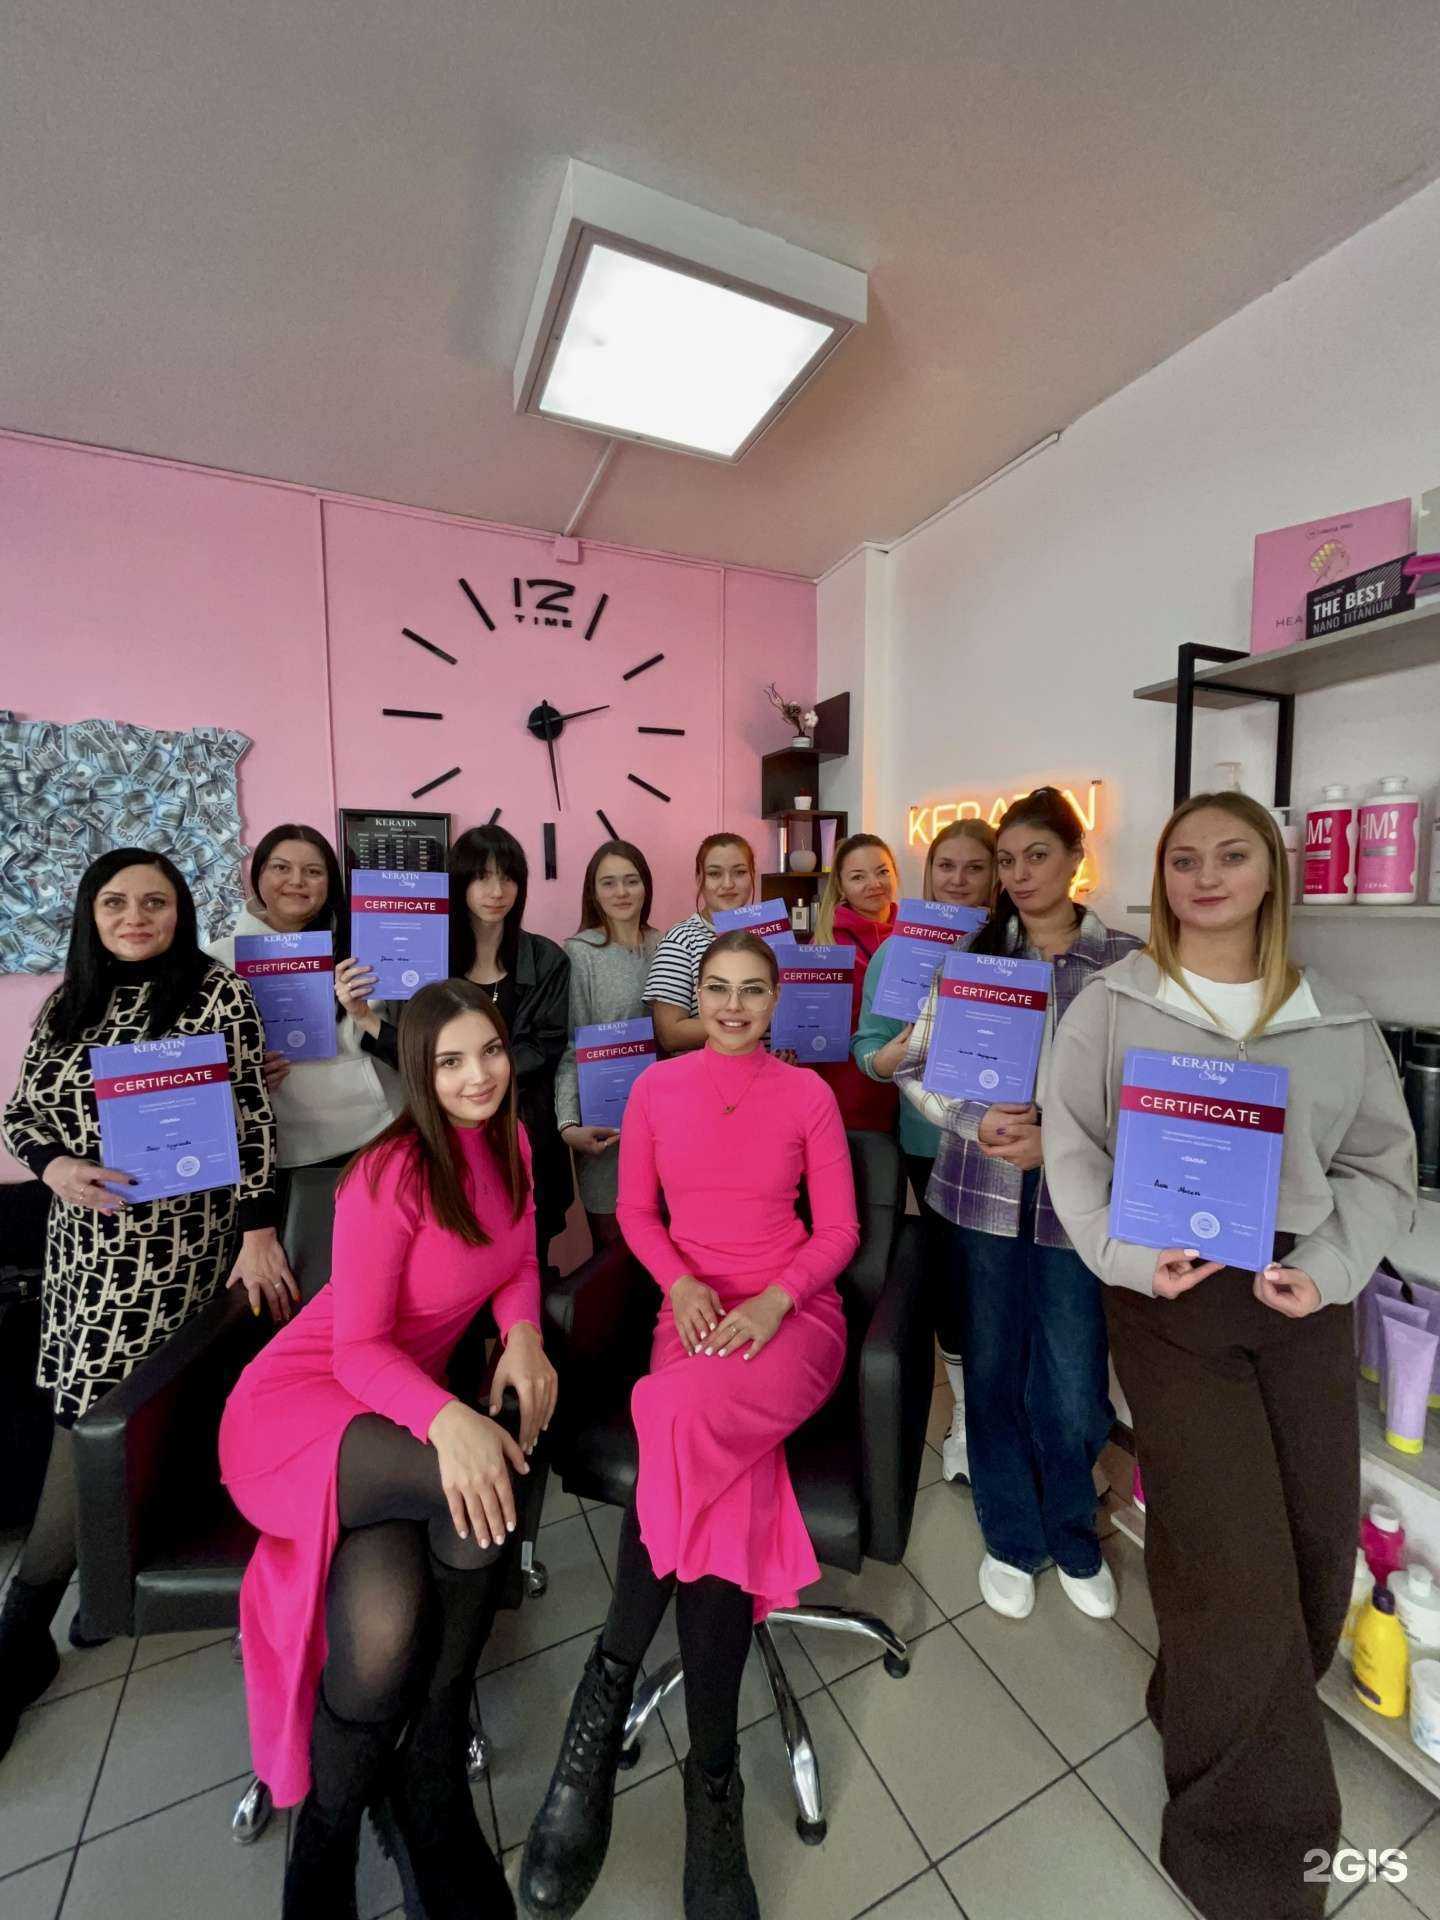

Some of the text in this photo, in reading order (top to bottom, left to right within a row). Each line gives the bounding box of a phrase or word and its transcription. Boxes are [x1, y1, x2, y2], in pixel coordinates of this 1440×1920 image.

[513, 577, 576, 613] 12
[1312, 598, 1341, 621] THE
[1345, 581, 1385, 610] BEST
[514, 614, 572, 628] TIME
[1275, 615, 1303, 629] HEA
[1312, 599, 1394, 634] NANO TITANIUM
[375, 818, 417, 827] KERATIN
[908, 785, 1097, 846] KERAN
[1305, 816, 1334, 845] M!
[382, 871, 419, 880] KERATIN
[364, 900, 436, 911] CERTIFICATE
[925, 903, 960, 914] KERATIN
[749, 923, 782, 936] FICATE
[903, 926, 961, 942] CERTIFICAT
[799, 945, 831, 953] KERATIN
[247, 960, 320, 973] CERTIFICATE
[976, 956, 1018, 968] KERATIN
[783, 972, 844, 981] CERTIFICATE
[953, 985, 1033, 1005] CERTIFICATE
[133, 1040, 185, 1054] KERATIN
[586, 1044, 645, 1059] CERTIFICATE
[1171, 1055, 1235, 1073] KERATIN
[114, 1070, 213, 1093] CERTIFICATE
[1140, 1095, 1261, 1125] CERTIFICATE
